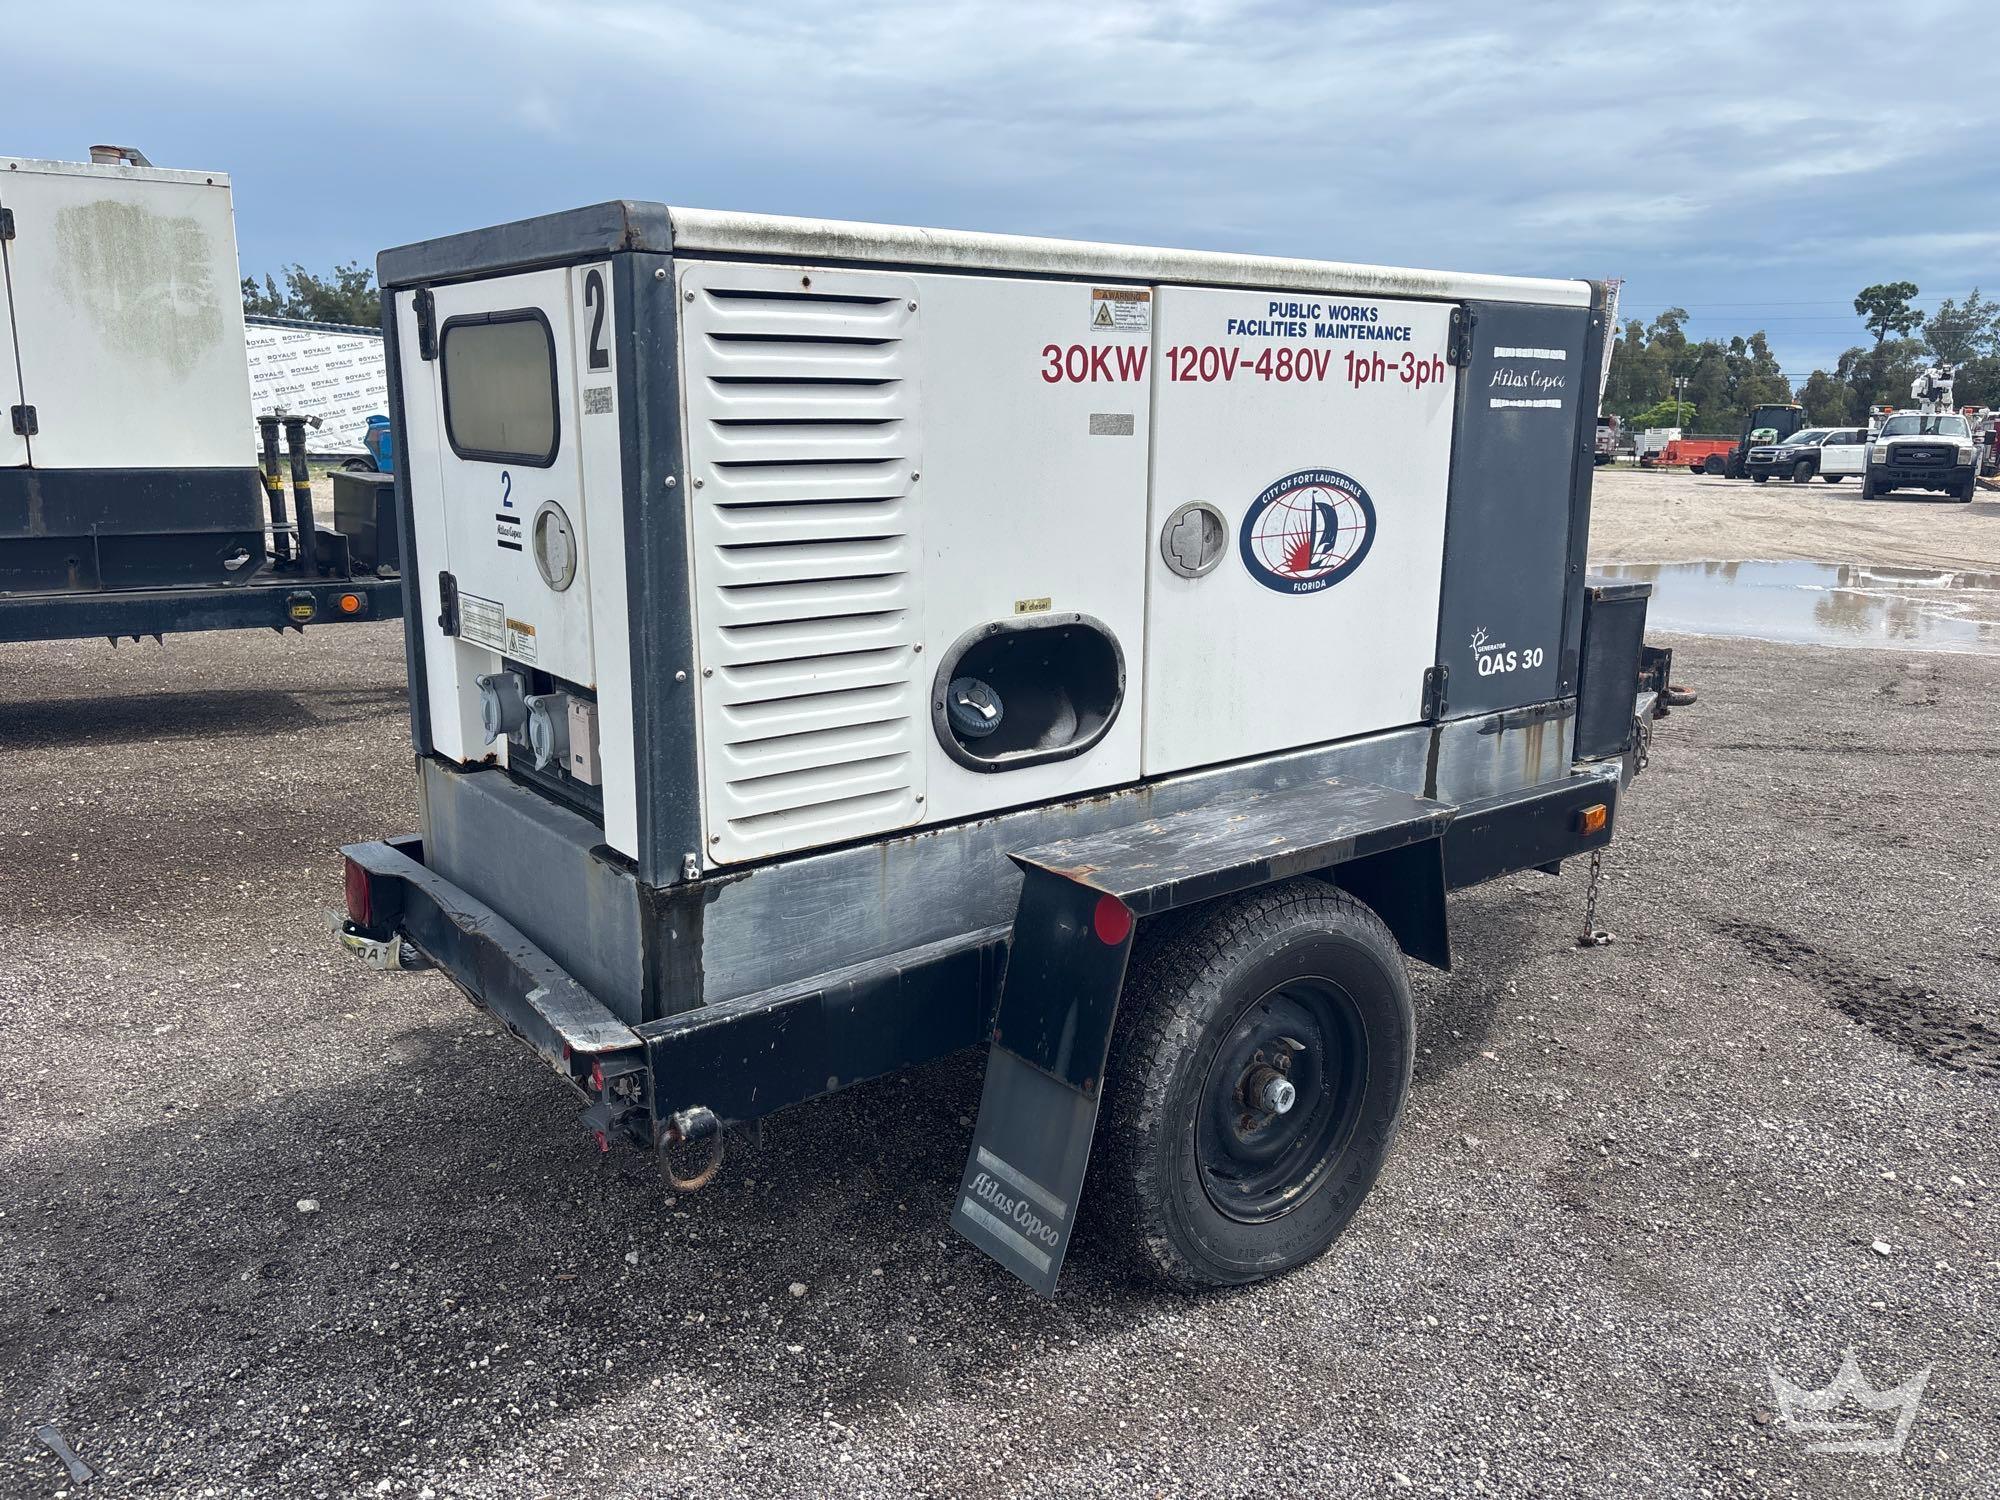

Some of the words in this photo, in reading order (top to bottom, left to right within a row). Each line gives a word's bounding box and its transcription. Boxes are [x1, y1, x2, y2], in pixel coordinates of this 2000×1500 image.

[585, 269, 609, 368] 2
[1269, 301, 1321, 320] PUBLIC
[1328, 305, 1378, 322] WORKS
[1227, 319, 1307, 338] FACILITIES
[1314, 323, 1411, 341] MAINTENANCE
[254, 371, 277, 379] ROYAL
[1041, 344, 1148, 383] 30KW
[1166, 346, 1331, 382] 120V-480V
[1344, 350, 1445, 389] 1ph-3ph
[501, 471, 513, 508] 2
[1262, 486, 1279, 503] CITY
[1280, 480, 1292, 491] OF
[1293, 474, 1314, 485] FORT
[1315, 474, 1362, 498] LAUDERDALE
[1293, 579, 1326, 592] FLORIDA
[1477, 642, 1506, 652] GENERATOR
[1478, 651, 1517, 676] QAS
[1522, 648, 1543, 669] 30
